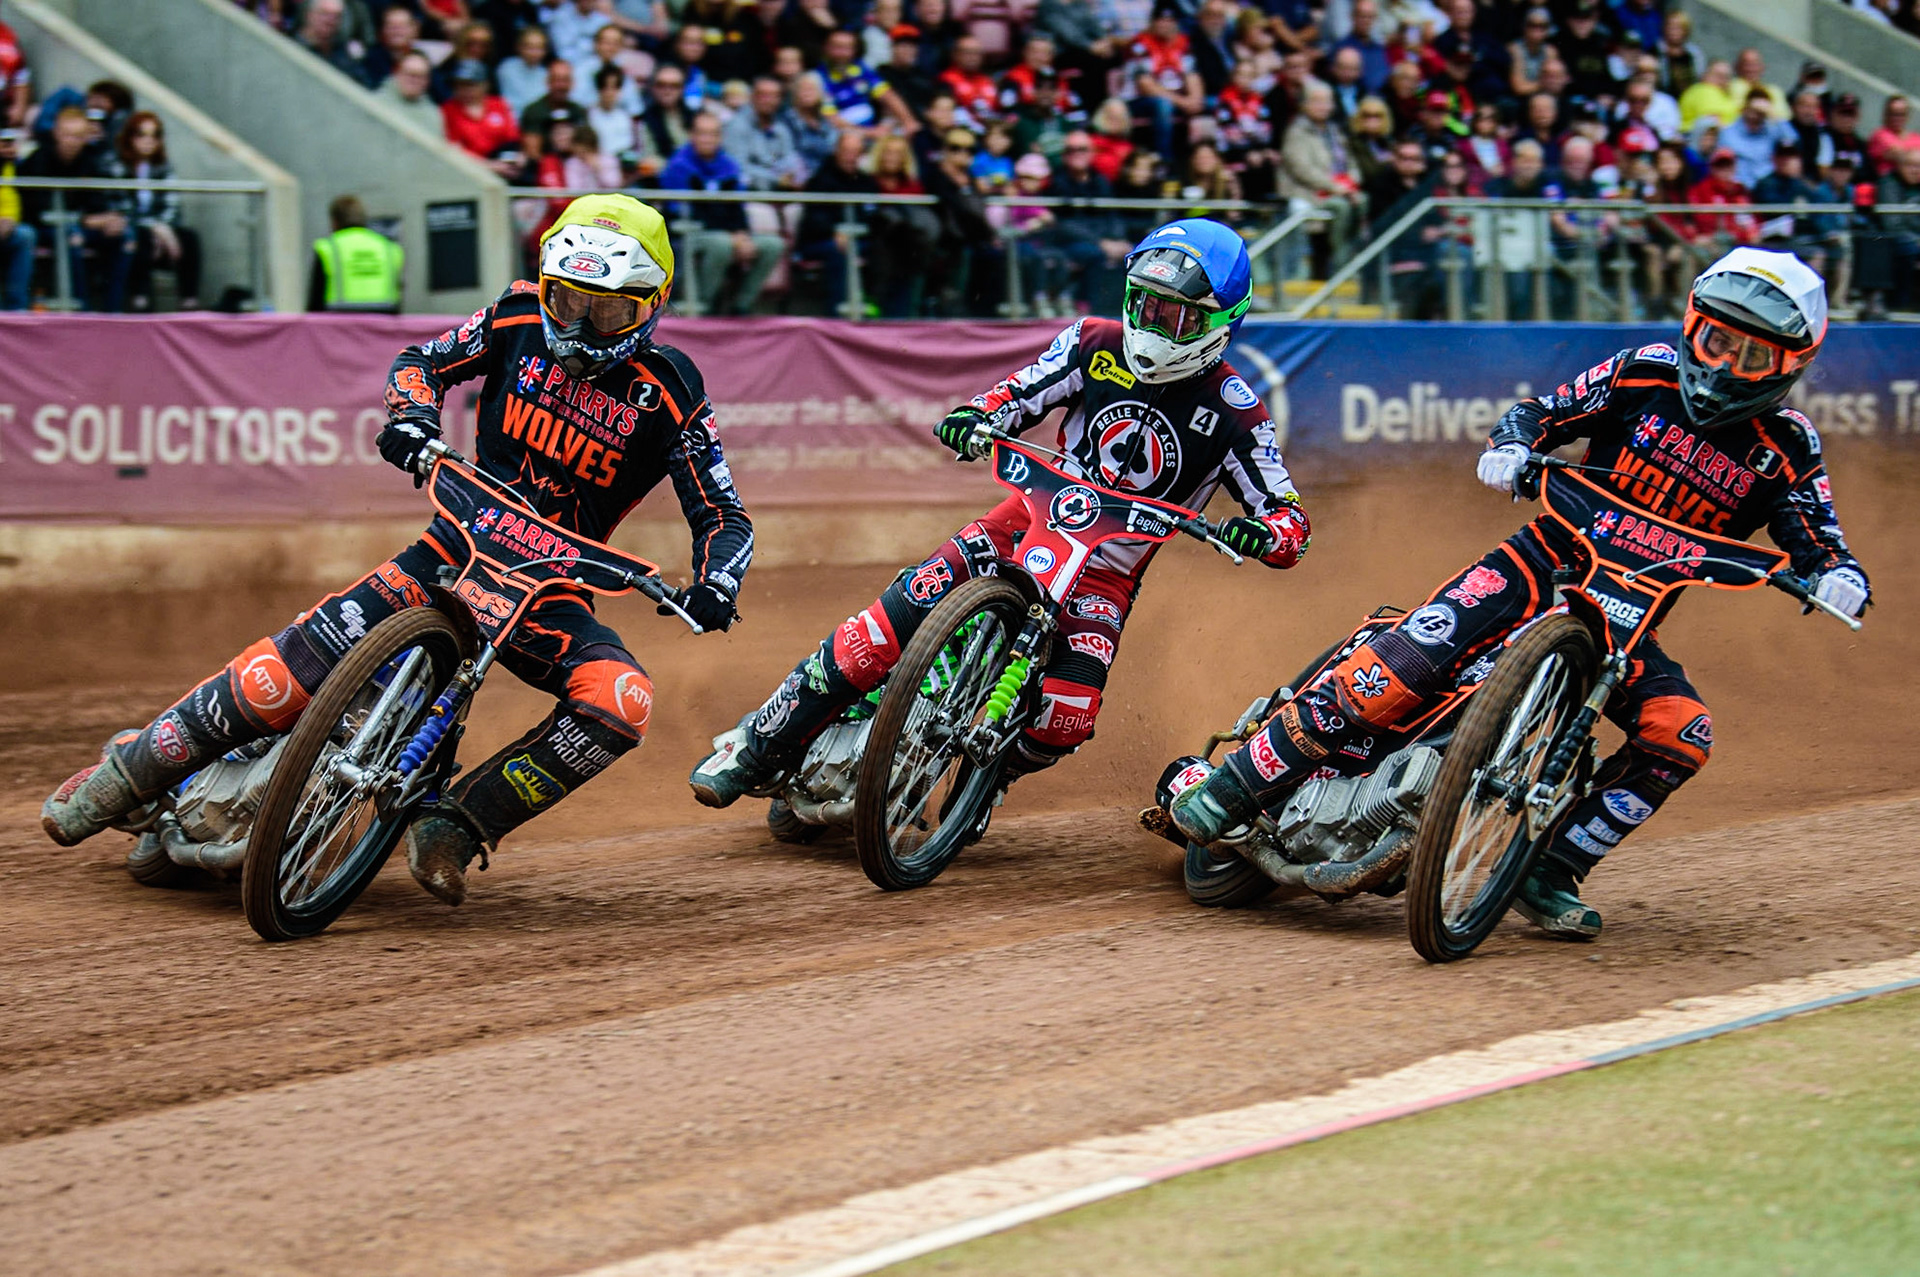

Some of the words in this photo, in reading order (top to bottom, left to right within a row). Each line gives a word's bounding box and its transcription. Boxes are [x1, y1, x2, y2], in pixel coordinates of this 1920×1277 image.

[567, 258, 602, 271] STS
[544, 364, 638, 437] PARRYS
[638, 383, 652, 407] 2
[1230, 381, 1252, 401] ATPI
[33, 404, 475, 466] SOLICITORS.C
[538, 392, 626, 450] INTERNATIONAL
[1096, 407, 1132, 431] BELLE
[1160, 433, 1176, 468] ACES
[1195, 410, 1214, 434] 4
[502, 392, 623, 488] WOLVES
[1659, 424, 1756, 498] PARRYS
[1756, 449, 1775, 473] 3
[1651, 448, 1740, 510] INTERNATIONAL
[496, 511, 581, 568] PARRYS
[1135, 514, 1167, 537] agilia
[1616, 515, 1707, 567] PARRYS
[1029, 553, 1050, 567] ATPI
[456, 579, 516, 618] CFS
[1080, 602, 1118, 619] STS
[470, 606, 502, 628] RATION
[1416, 615, 1452, 632] 45
[843, 623, 873, 669] agilia
[1069, 633, 1114, 655] NGK
[252, 666, 280, 700] ATPI
[625, 685, 652, 711] ATP
[557, 715, 591, 750] BLUE
[1053, 713, 1095, 734] agilia
[161, 726, 182, 760] STS
[1255, 731, 1286, 776] NGK
[1178, 766, 1206, 787] NG
